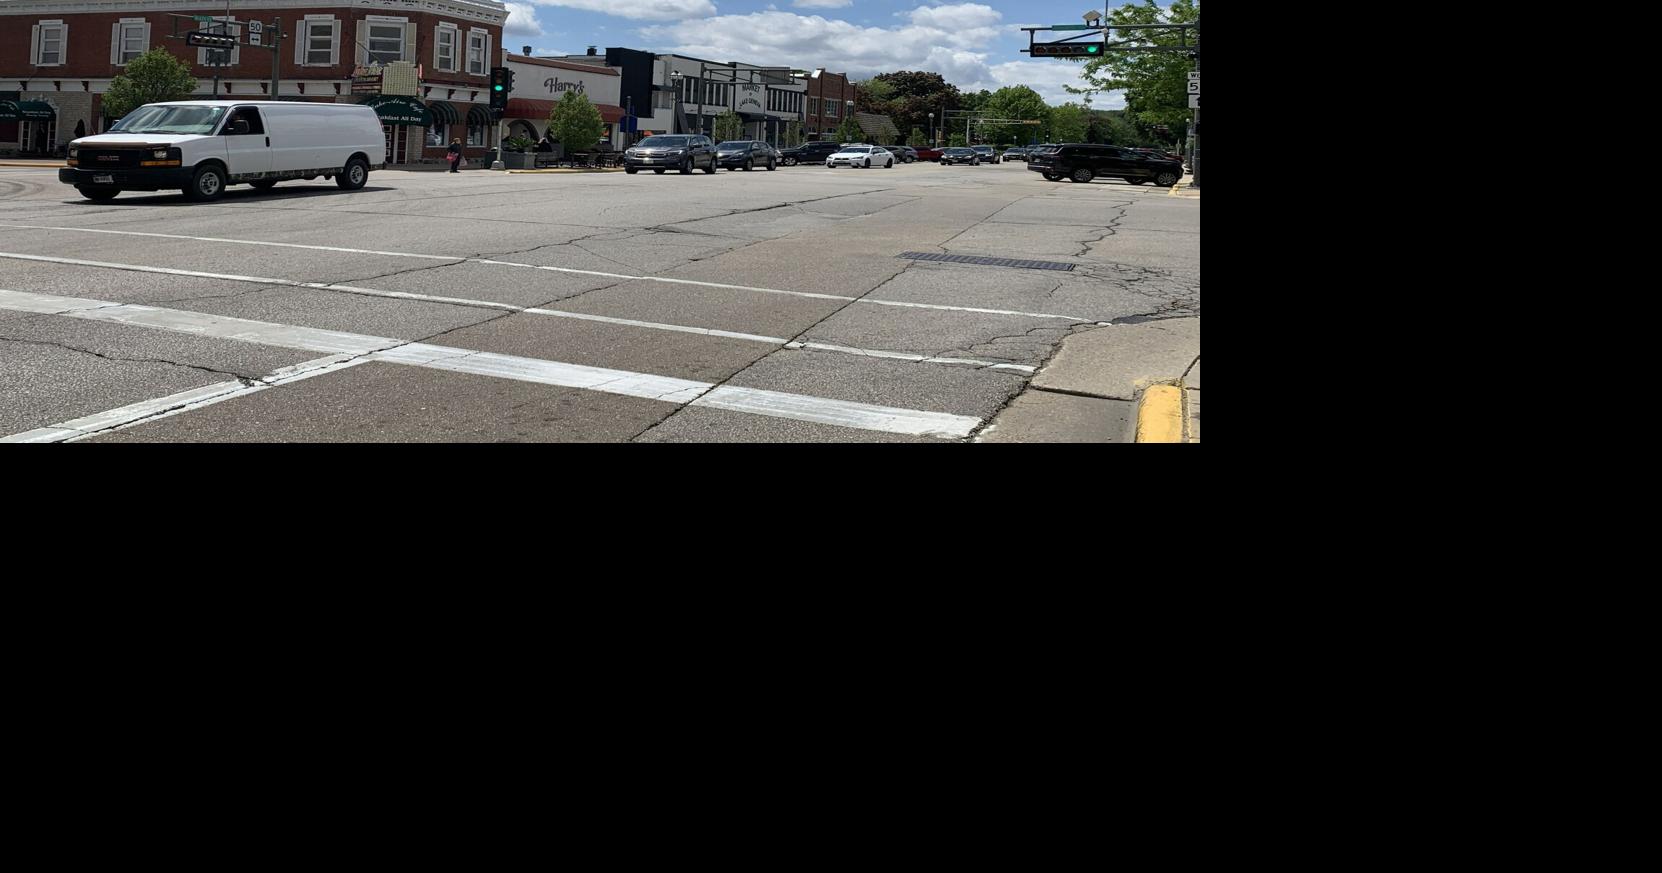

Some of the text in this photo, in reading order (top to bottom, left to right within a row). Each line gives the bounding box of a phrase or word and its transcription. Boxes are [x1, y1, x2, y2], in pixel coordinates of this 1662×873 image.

[250, 22, 261, 31] 50
[544, 77, 585, 96] Harry's
[742, 83, 760, 92] MARKET
